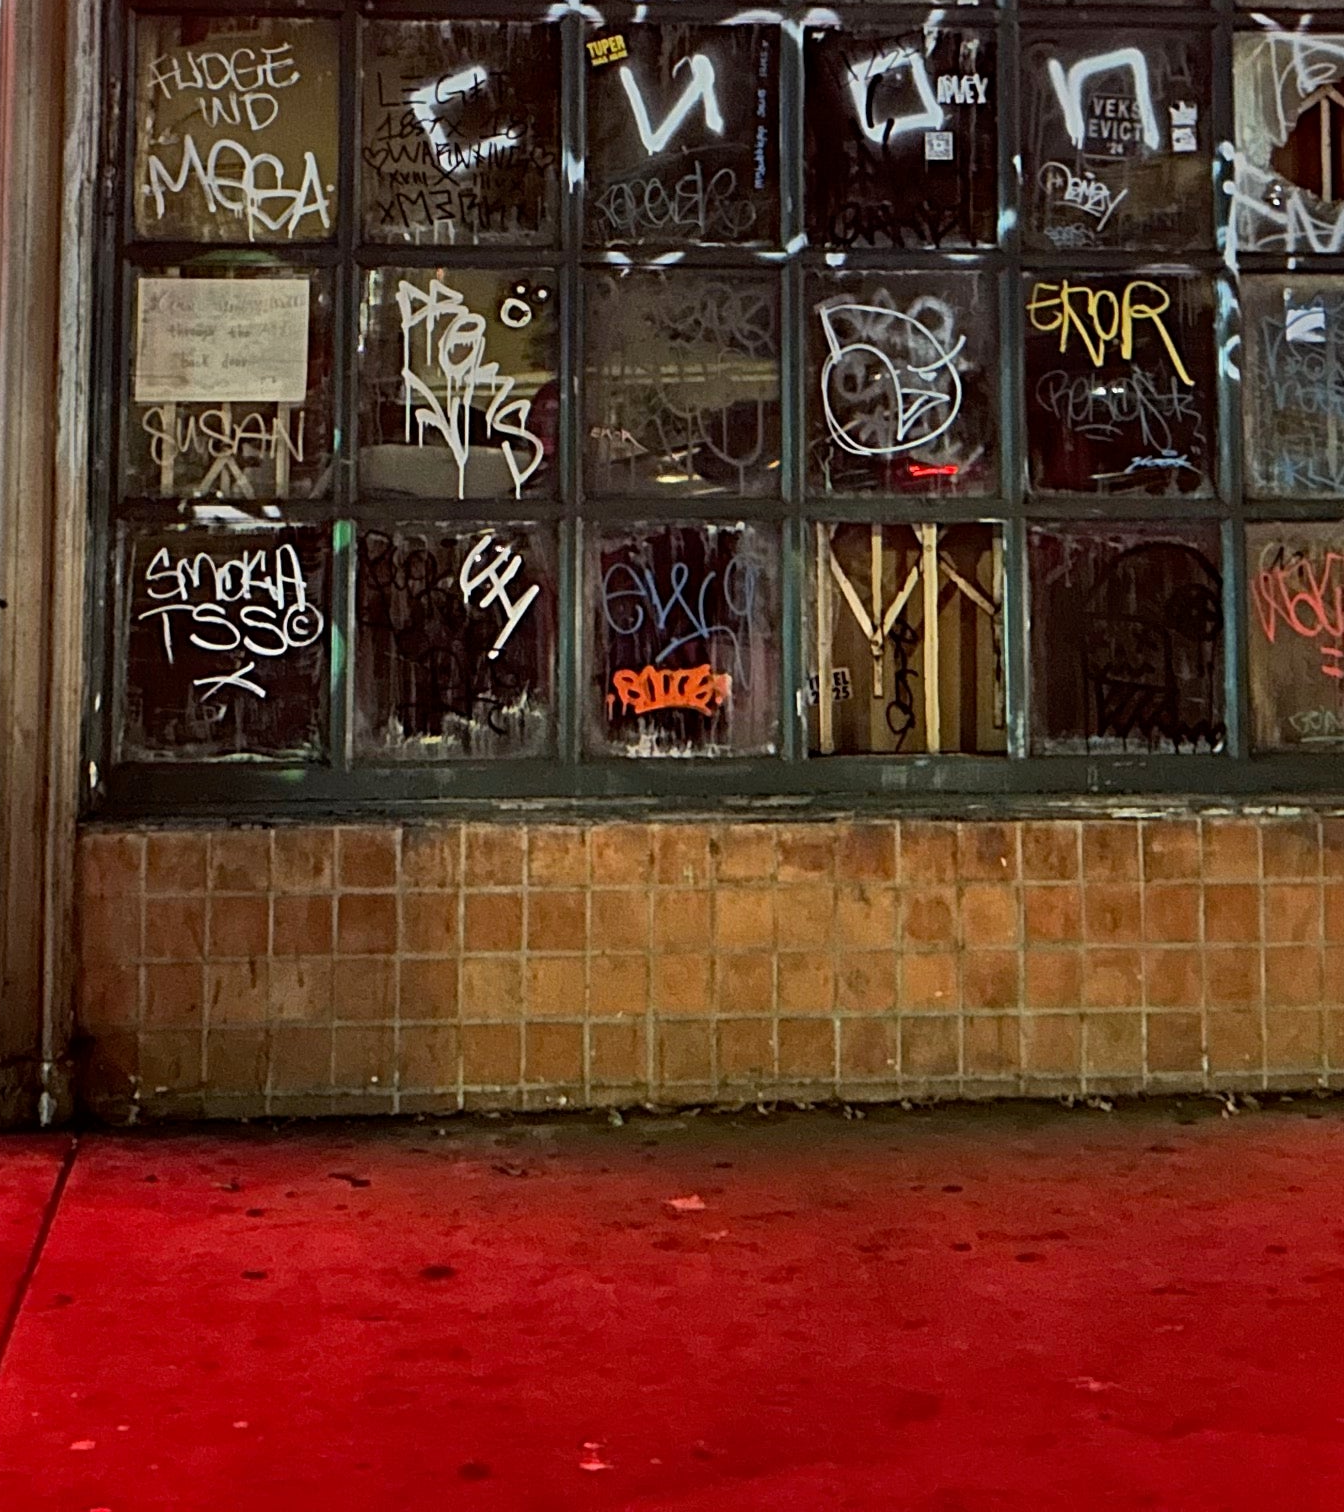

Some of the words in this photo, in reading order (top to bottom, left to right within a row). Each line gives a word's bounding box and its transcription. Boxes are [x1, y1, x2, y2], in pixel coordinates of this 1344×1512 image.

[146, 41, 302, 100] FUDGE
[1087, 118, 1144, 142] EVICT
[141, 406, 305, 467] SUSAN
